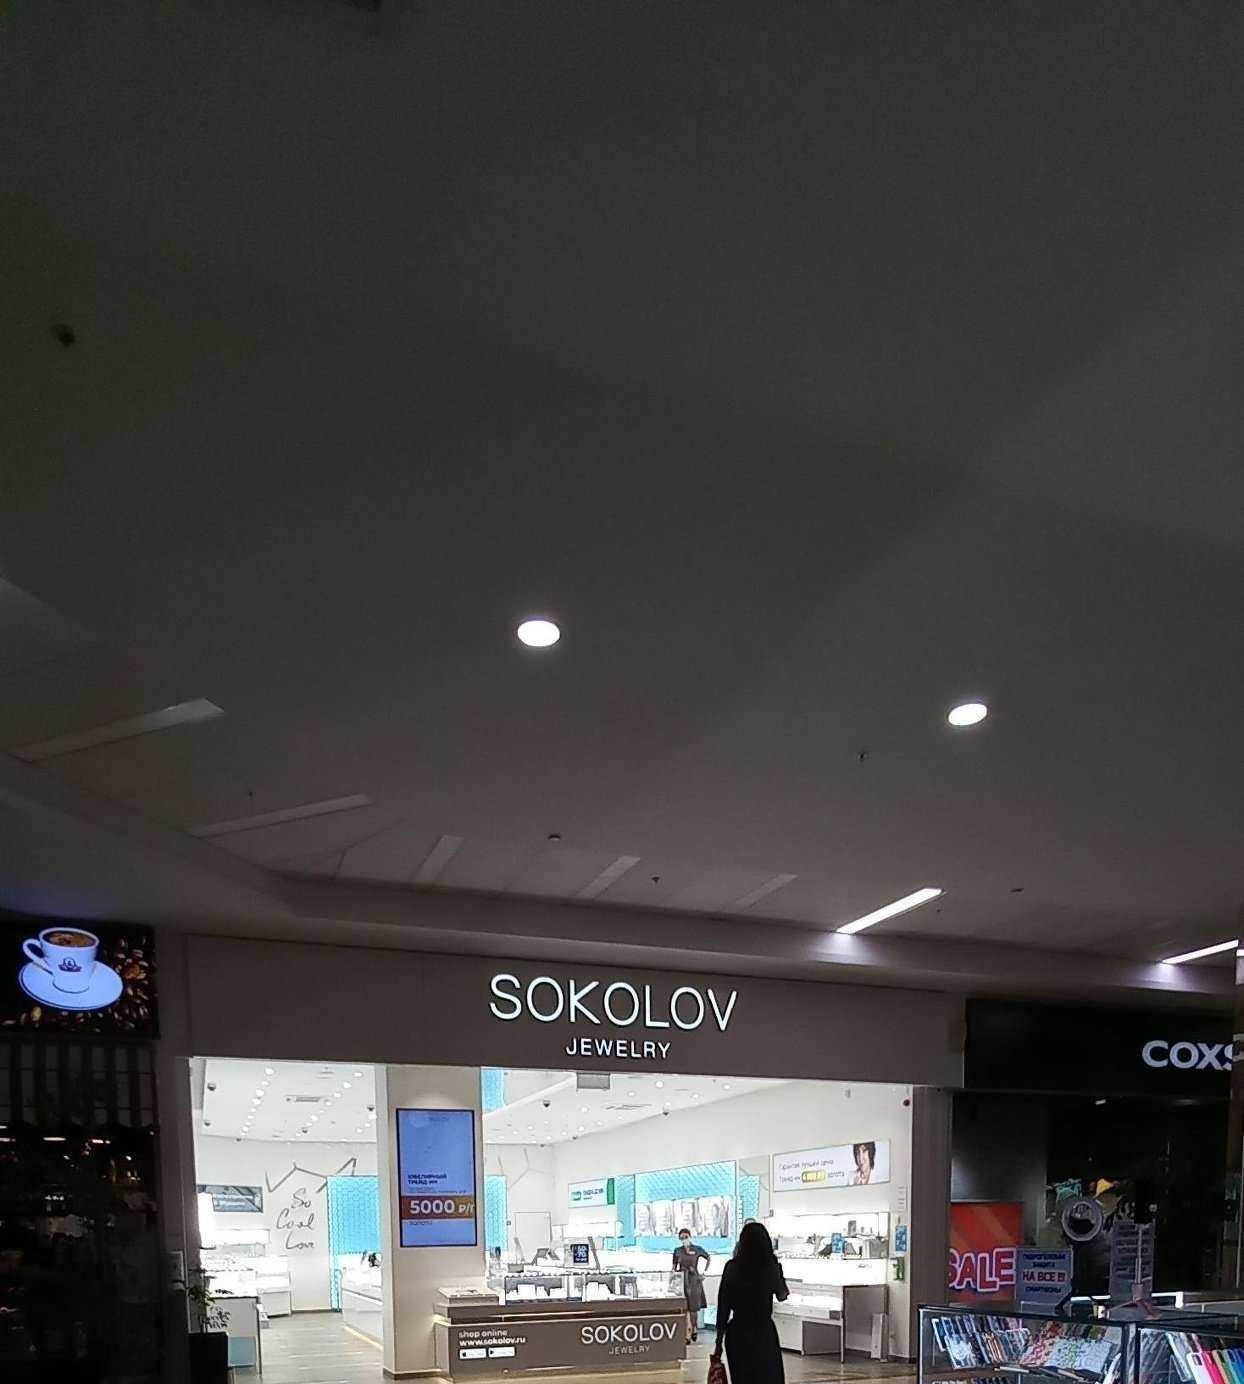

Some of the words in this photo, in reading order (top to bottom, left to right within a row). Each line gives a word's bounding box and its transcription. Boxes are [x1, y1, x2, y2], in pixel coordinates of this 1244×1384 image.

[489, 973, 737, 1032] SOKOLOV
[565, 1038, 671, 1059] JEWELRY
[409, 1199, 455, 1215] 5000
[1022, 1271, 1035, 1281] НА
[1037, 1271, 1056, 1282] ВСЕ
[459, 1329, 480, 1339] shop
[481, 1328, 508, 1338] online
[581, 1322, 677, 1345] SOKOLOV
[459, 1337, 526, 1347] www.sokolov.ru
[608, 1346, 650, 1355] JEWELRY
